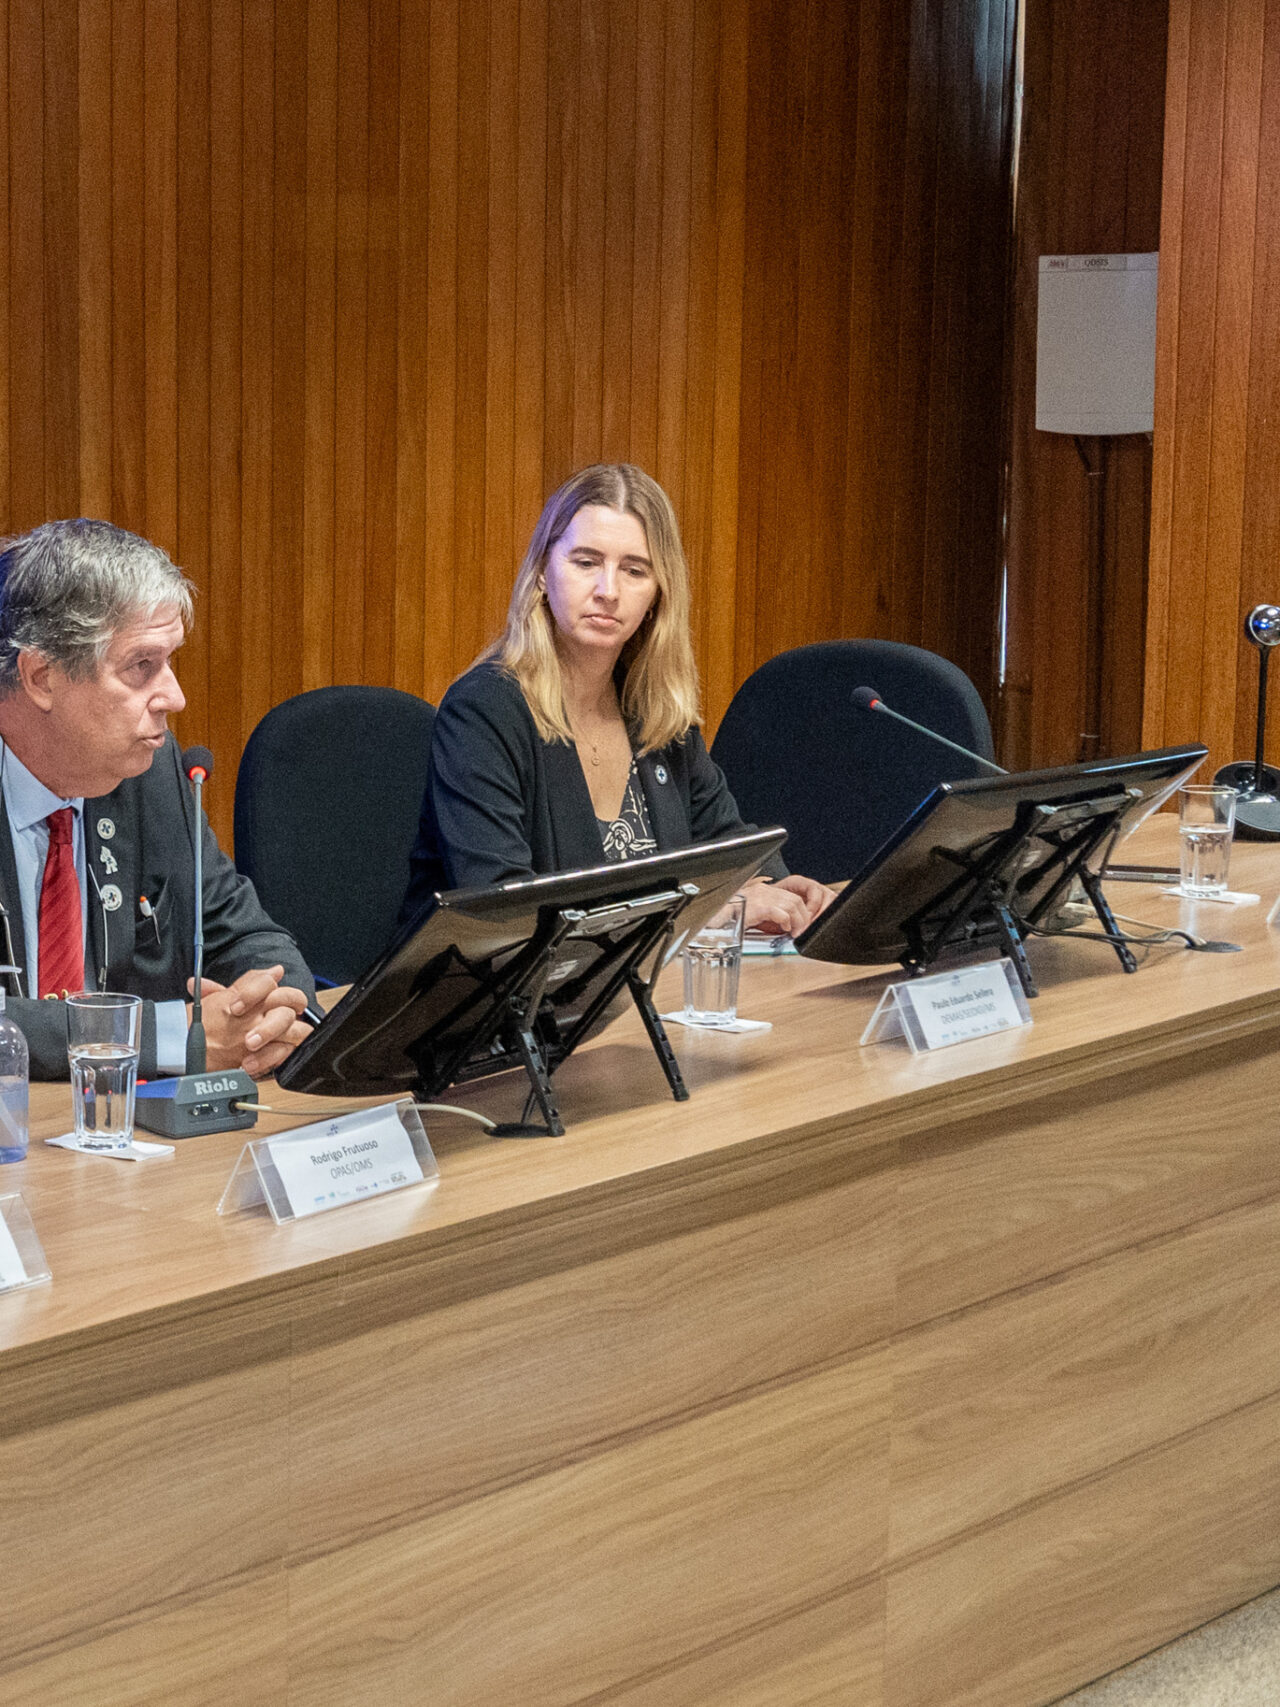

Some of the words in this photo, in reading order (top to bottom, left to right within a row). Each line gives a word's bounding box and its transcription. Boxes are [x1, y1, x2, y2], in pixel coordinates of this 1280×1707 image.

[194, 1078, 239, 1096] Riole
[310, 1149, 343, 1166] Rodrigo
[341, 1139, 379, 1157] Frutuoso
[330, 1158, 373, 1179] OPAS/OMS
